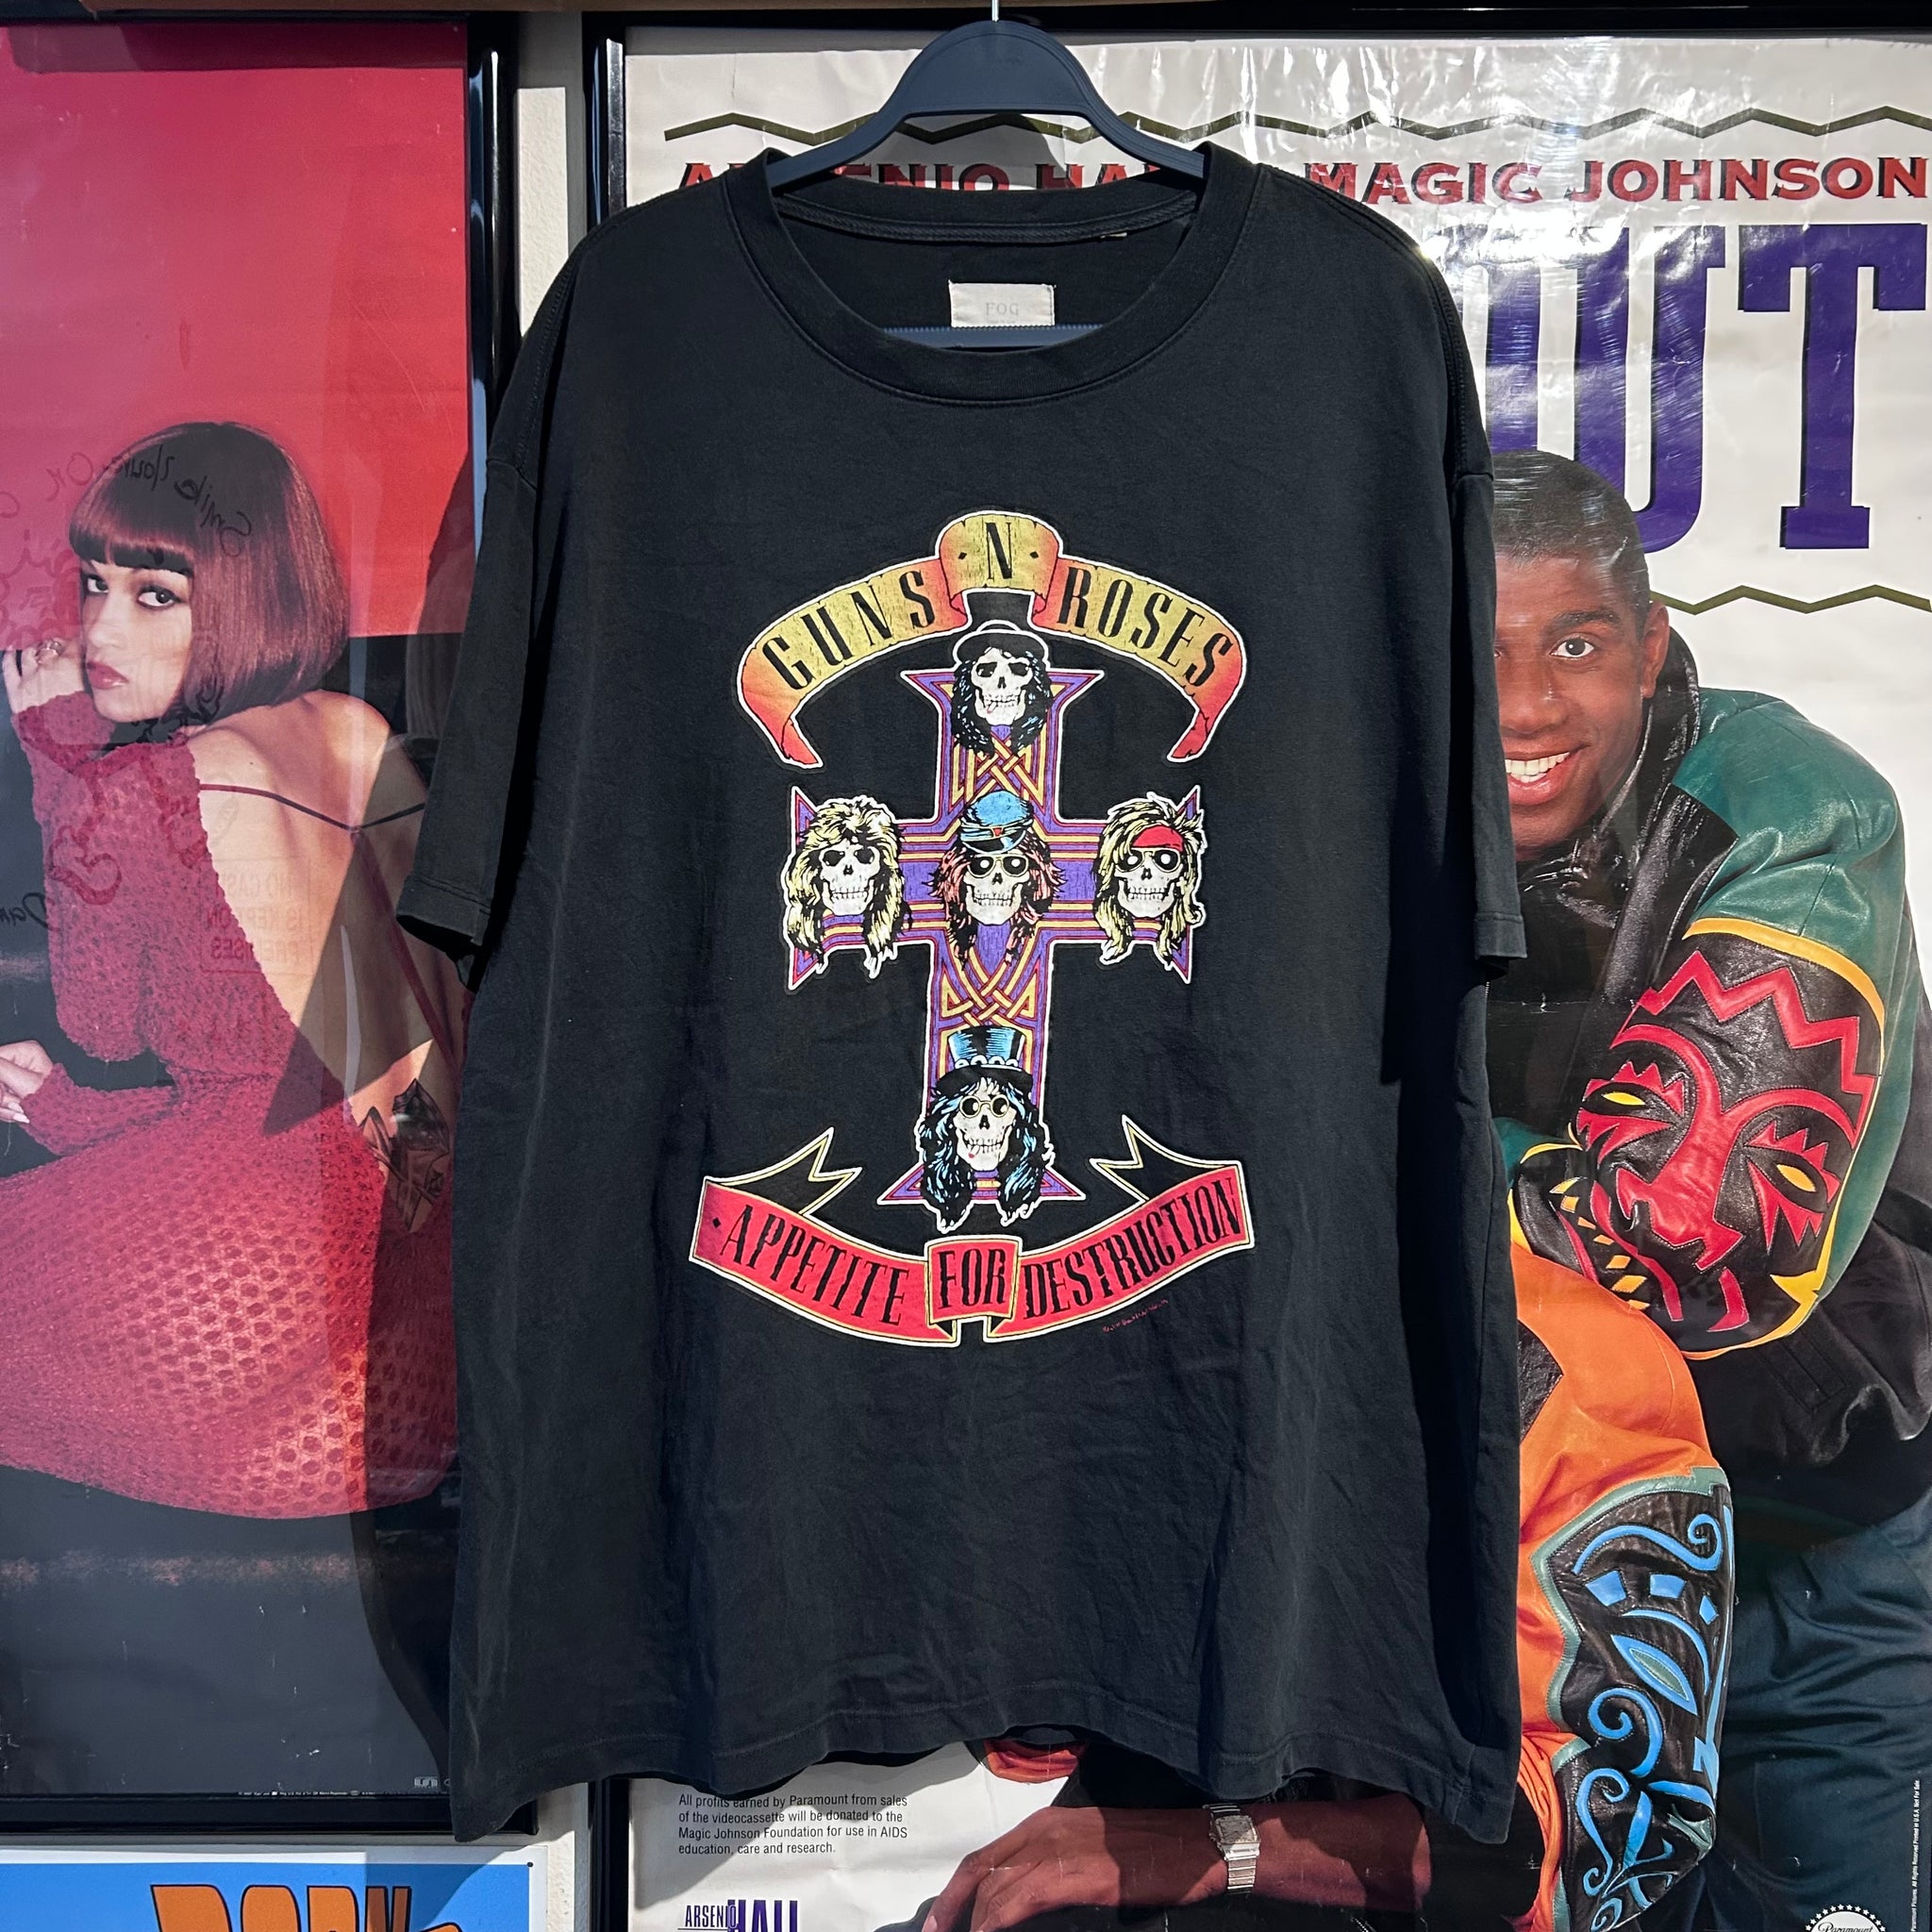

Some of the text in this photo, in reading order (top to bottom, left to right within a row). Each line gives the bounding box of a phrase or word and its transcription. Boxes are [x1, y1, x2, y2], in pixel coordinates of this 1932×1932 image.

[1304, 161, 1543, 205] MAGIC
[1564, 157, 1929, 203] JOHNSON
[986, 301, 1019, 317] FOG
[762, 570, 936, 691] GUNS
[1057, 566, 1234, 687] ROSES
[719, 1176, 1241, 1324] APPETITE FOR DESTRUCTION
[679, 1793, 908, 1808] All profits earned by Paramount from sales
[679, 1810, 903, 1823] of the videocassette will be donated to the
[679, 1825, 908, 1840] Magic Johnson Foundation for use in AIDS
[679, 1841, 836, 1856] education, care and research.
[685, 1904, 738, 1928] ARSENIO
